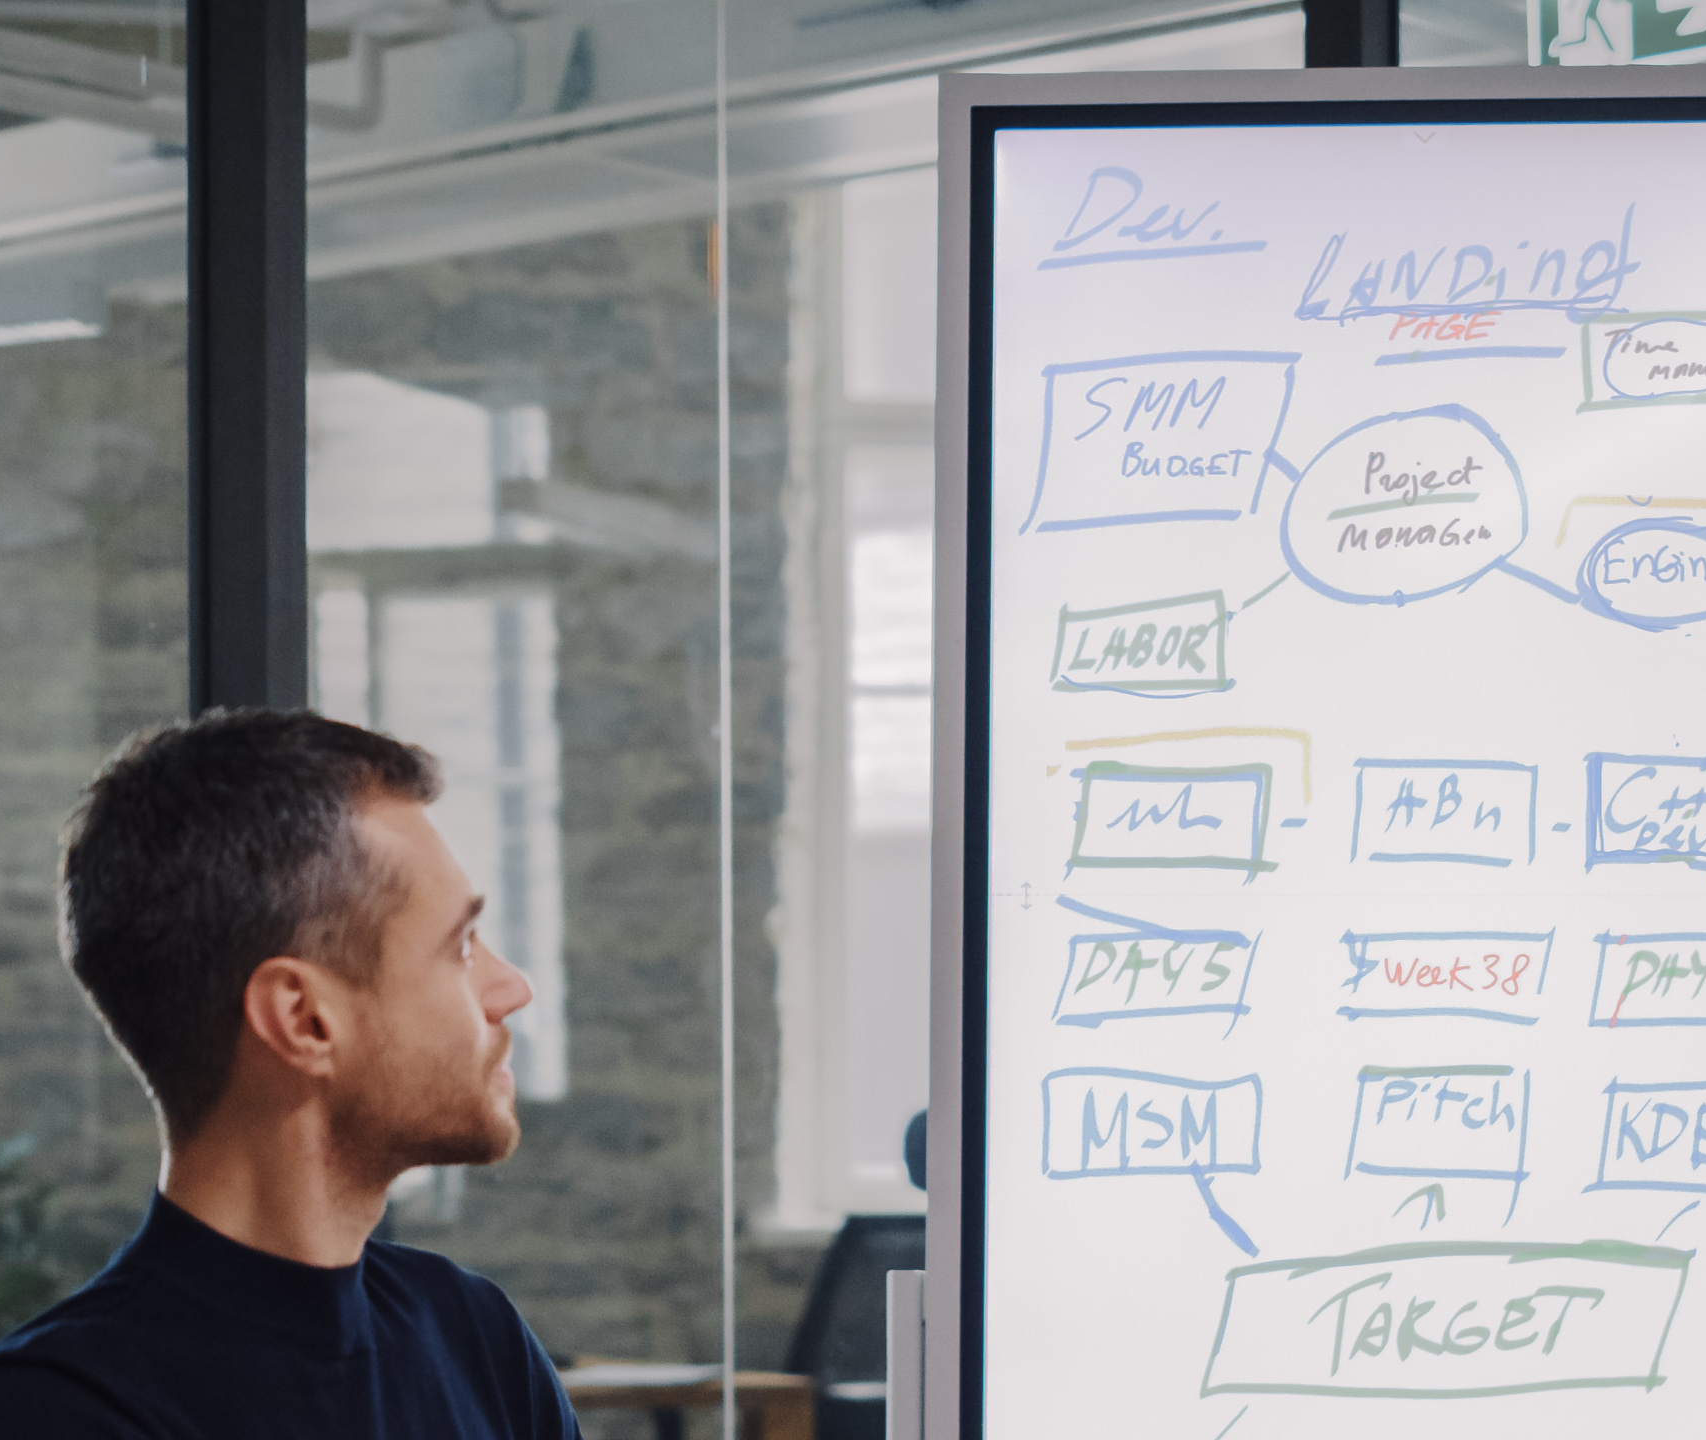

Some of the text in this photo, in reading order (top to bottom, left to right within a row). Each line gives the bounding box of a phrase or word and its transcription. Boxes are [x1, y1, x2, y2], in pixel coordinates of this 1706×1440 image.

[1388, 311, 1502, 341] PAGE
[1075, 375, 1228, 440] SMM
[1363, 451, 1484, 507] Project
[1067, 622, 1208, 674] LABOR
[1481, 953, 1531, 996] 38
[1081, 1089, 1219, 1172] MSM
[1376, 1077, 1515, 1133] Pitch
[1308, 1272, 1606, 1377] TARGET
